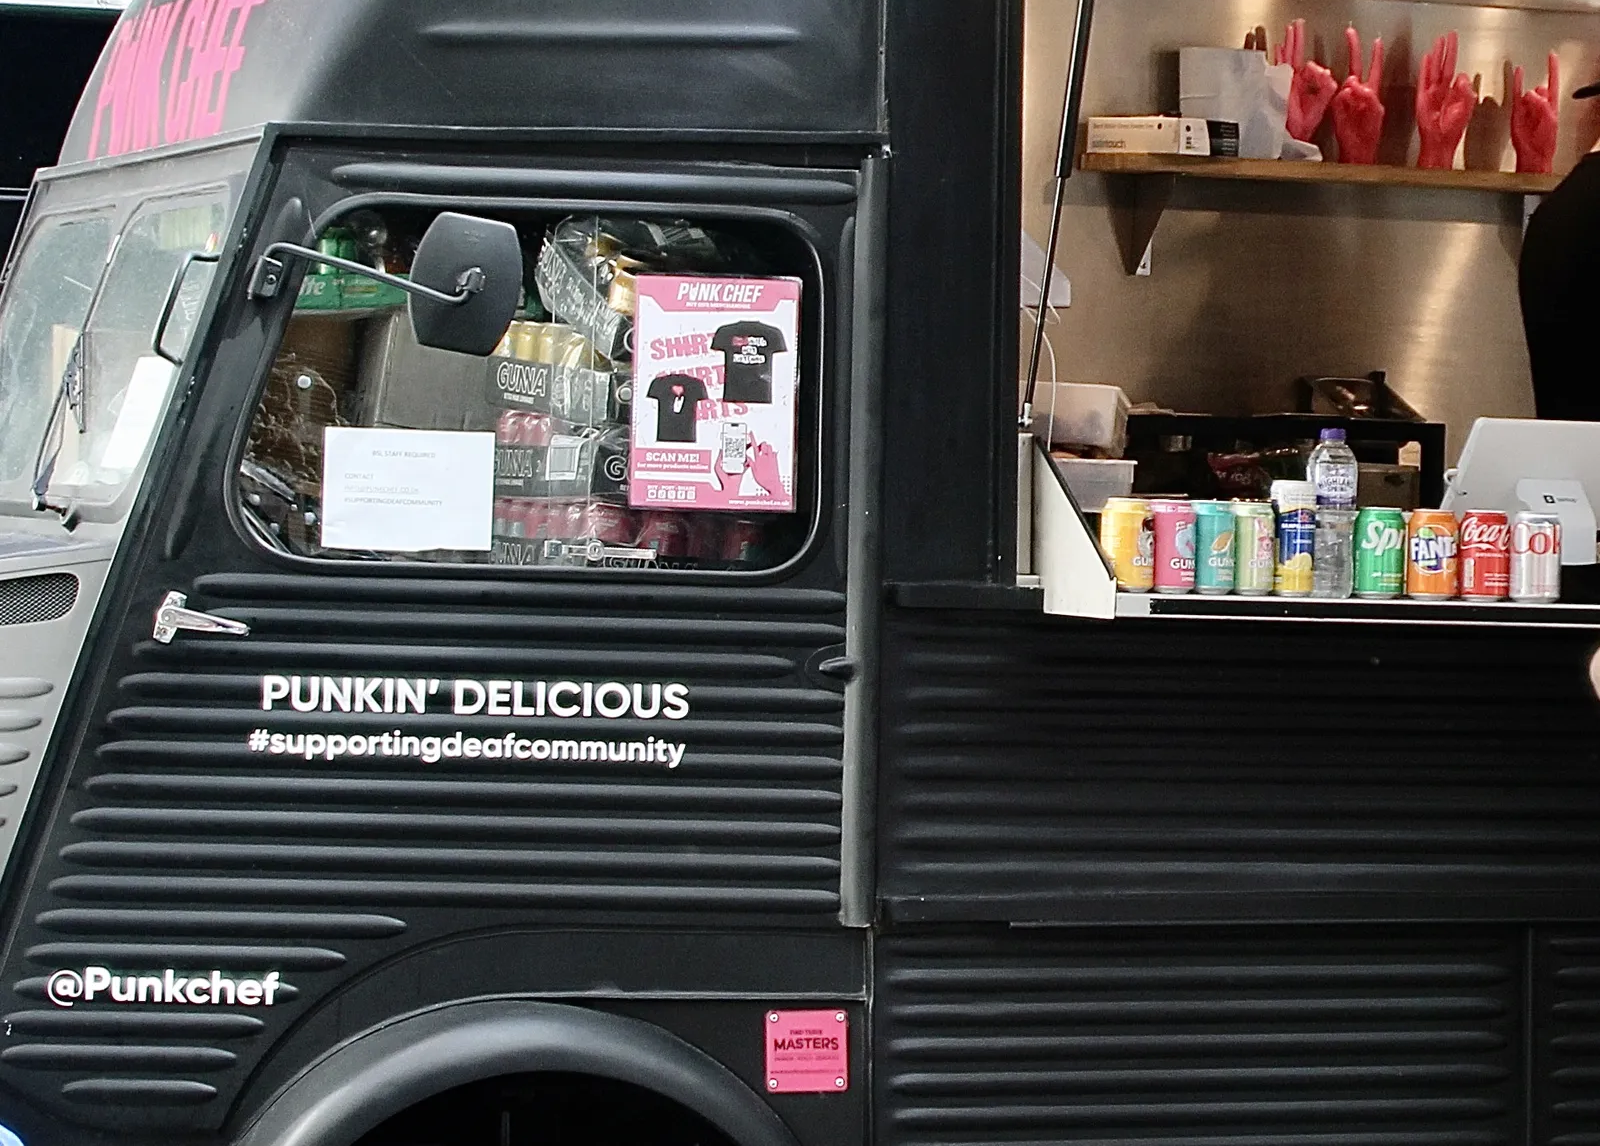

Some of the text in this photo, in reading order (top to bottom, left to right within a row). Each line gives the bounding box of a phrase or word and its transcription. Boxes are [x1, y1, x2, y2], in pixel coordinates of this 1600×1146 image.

[722, 284, 763, 303] CHEF
[650, 332, 716, 360] SHIR
[497, 361, 548, 397] GUNNA
[646, 452, 700, 463] SCAN ME!
[261, 675, 690, 720] PUNKIN' DELICIOUS
[248, 729, 687, 769] #supportingdeafcommunity
[47, 966, 280, 1006] @Punkchef
[774, 1038, 839, 1051] MASTERS
